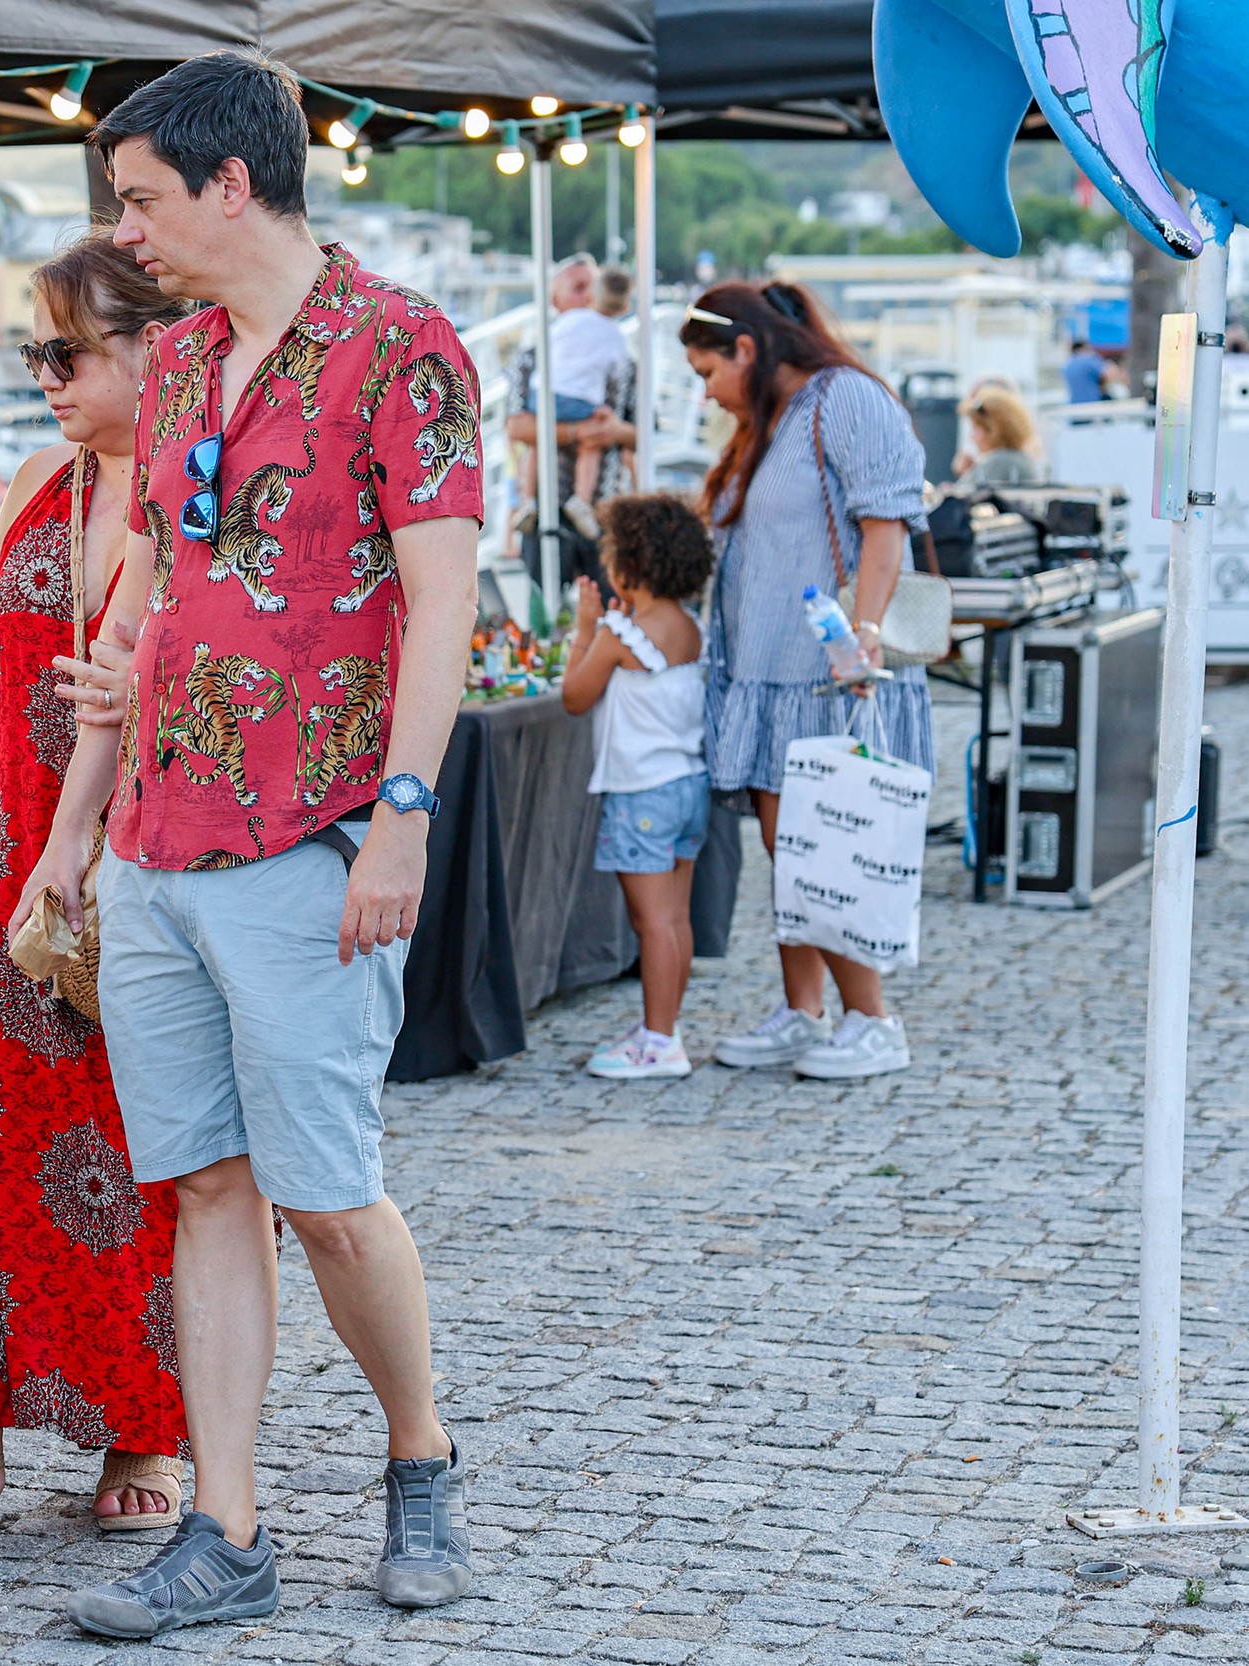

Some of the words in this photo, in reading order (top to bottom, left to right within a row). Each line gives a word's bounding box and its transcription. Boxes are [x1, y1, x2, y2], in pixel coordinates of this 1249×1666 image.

[815, 801, 842, 821] flying
[845, 810, 874, 828] tiger
[852, 852, 885, 875] flying
[794, 877, 825, 898] flying
[829, 888, 859, 904] tiger
